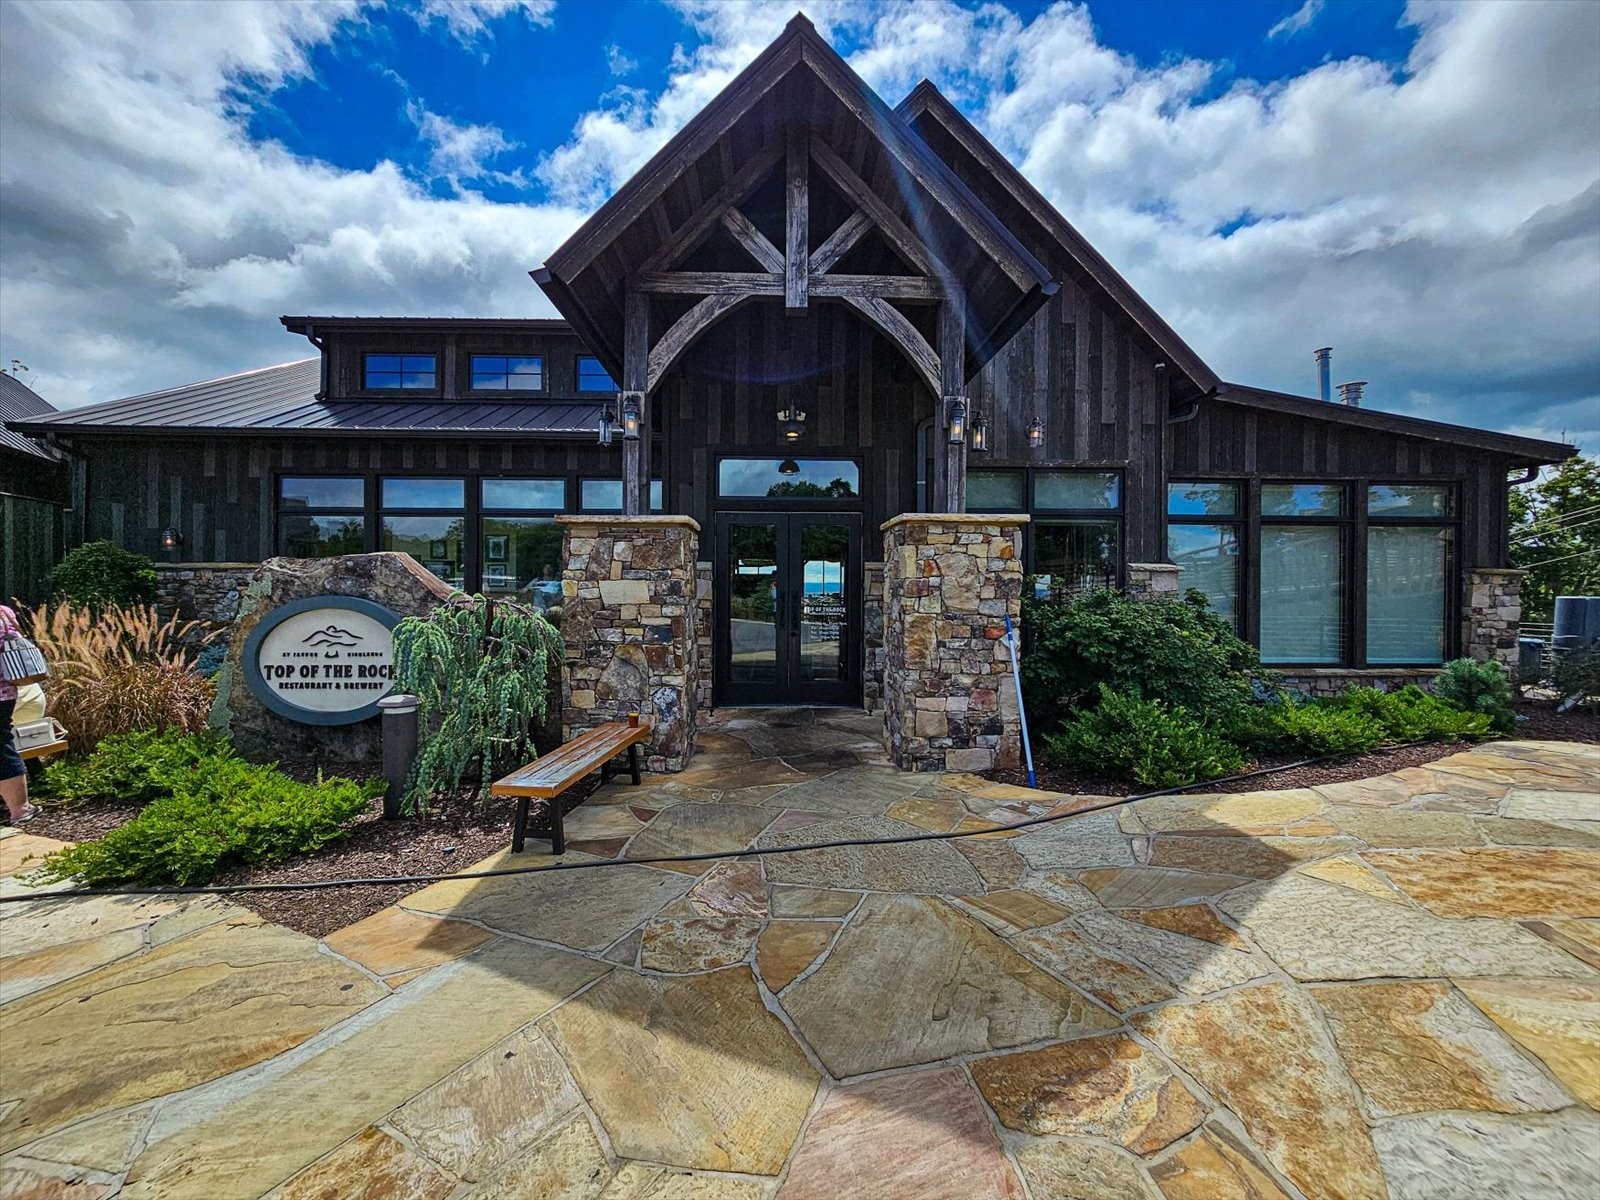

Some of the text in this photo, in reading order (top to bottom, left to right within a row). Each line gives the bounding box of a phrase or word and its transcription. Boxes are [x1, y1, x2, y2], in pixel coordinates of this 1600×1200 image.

[263, 664, 296, 681] TOP
[299, 664, 320, 679] OF
[323, 664, 353, 678] THE
[278, 682, 384, 690] RESTAURANT & BREWERY
